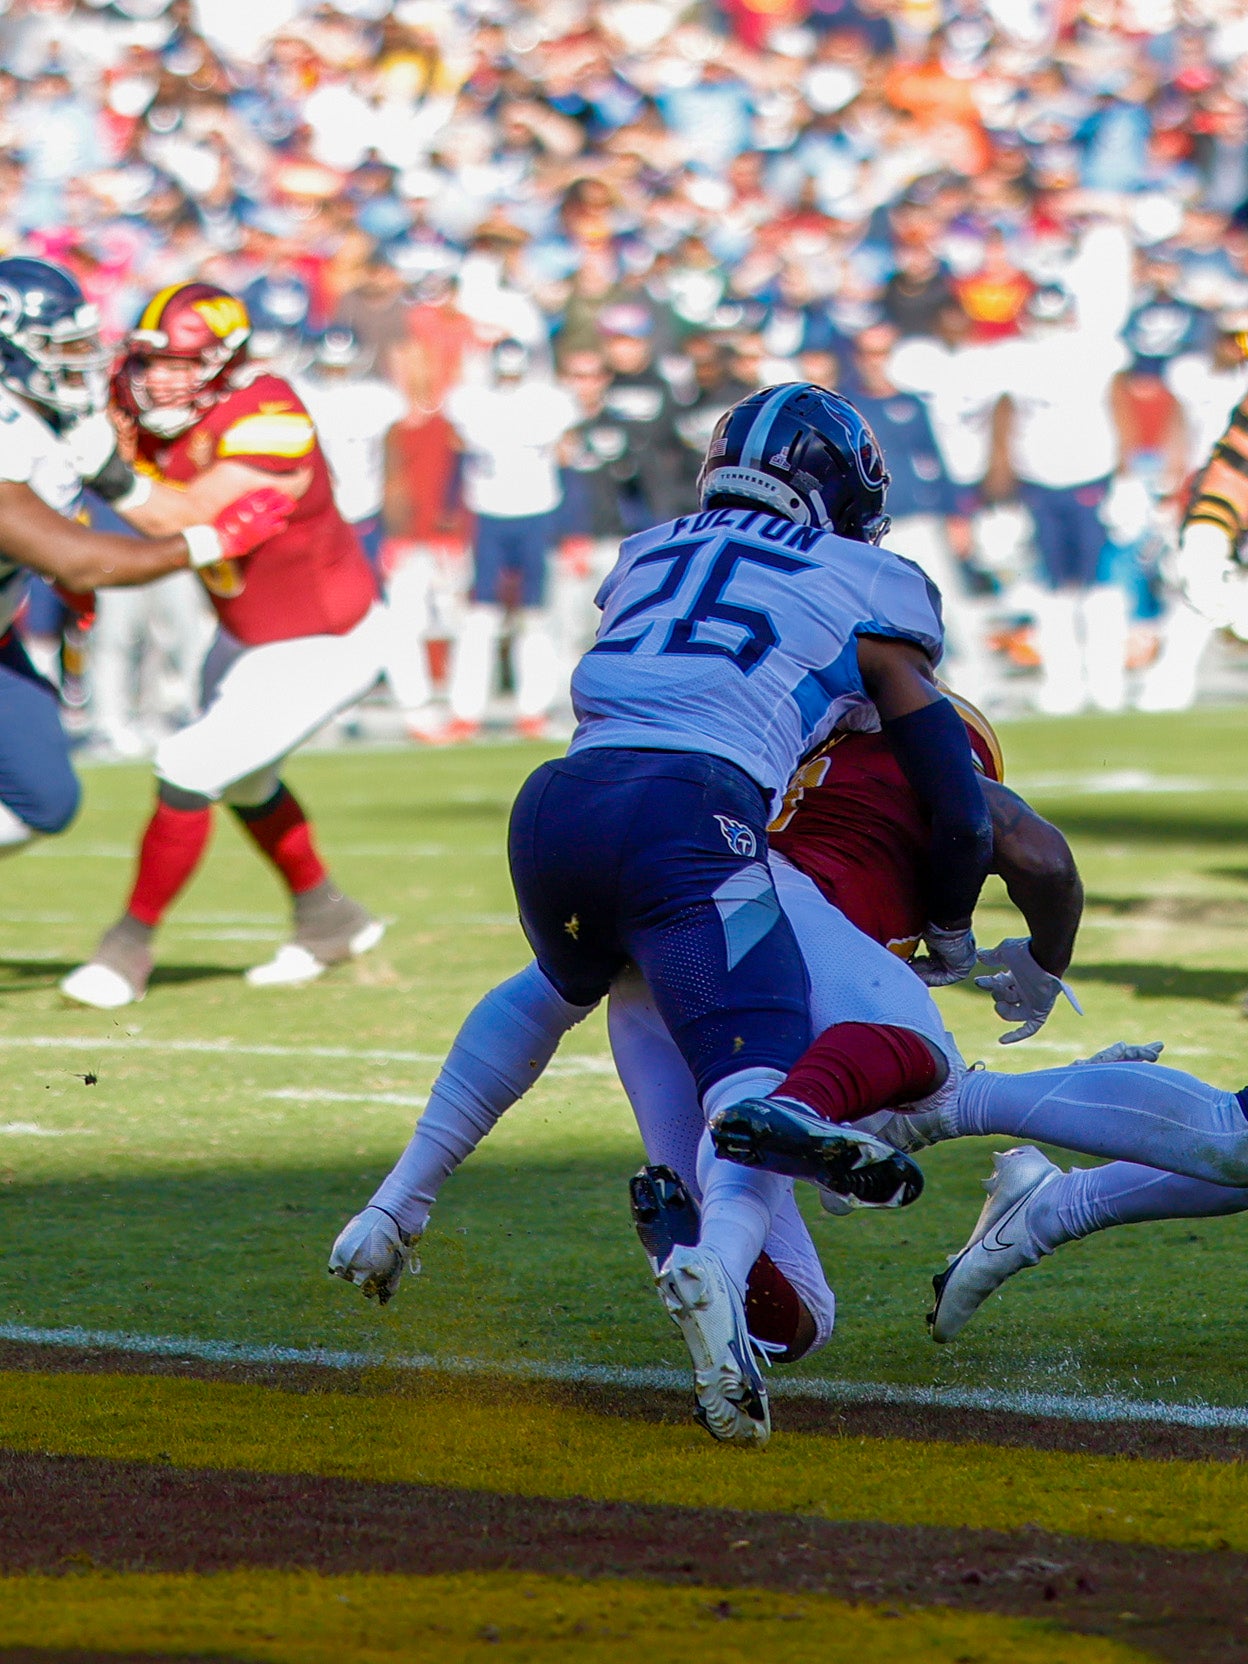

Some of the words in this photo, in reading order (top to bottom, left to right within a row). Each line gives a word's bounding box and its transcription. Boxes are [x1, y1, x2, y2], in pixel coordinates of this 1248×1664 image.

[721, 473, 777, 491] TENNESSEE
[664, 508, 827, 553] FULTON
[587, 534, 825, 675] 26
